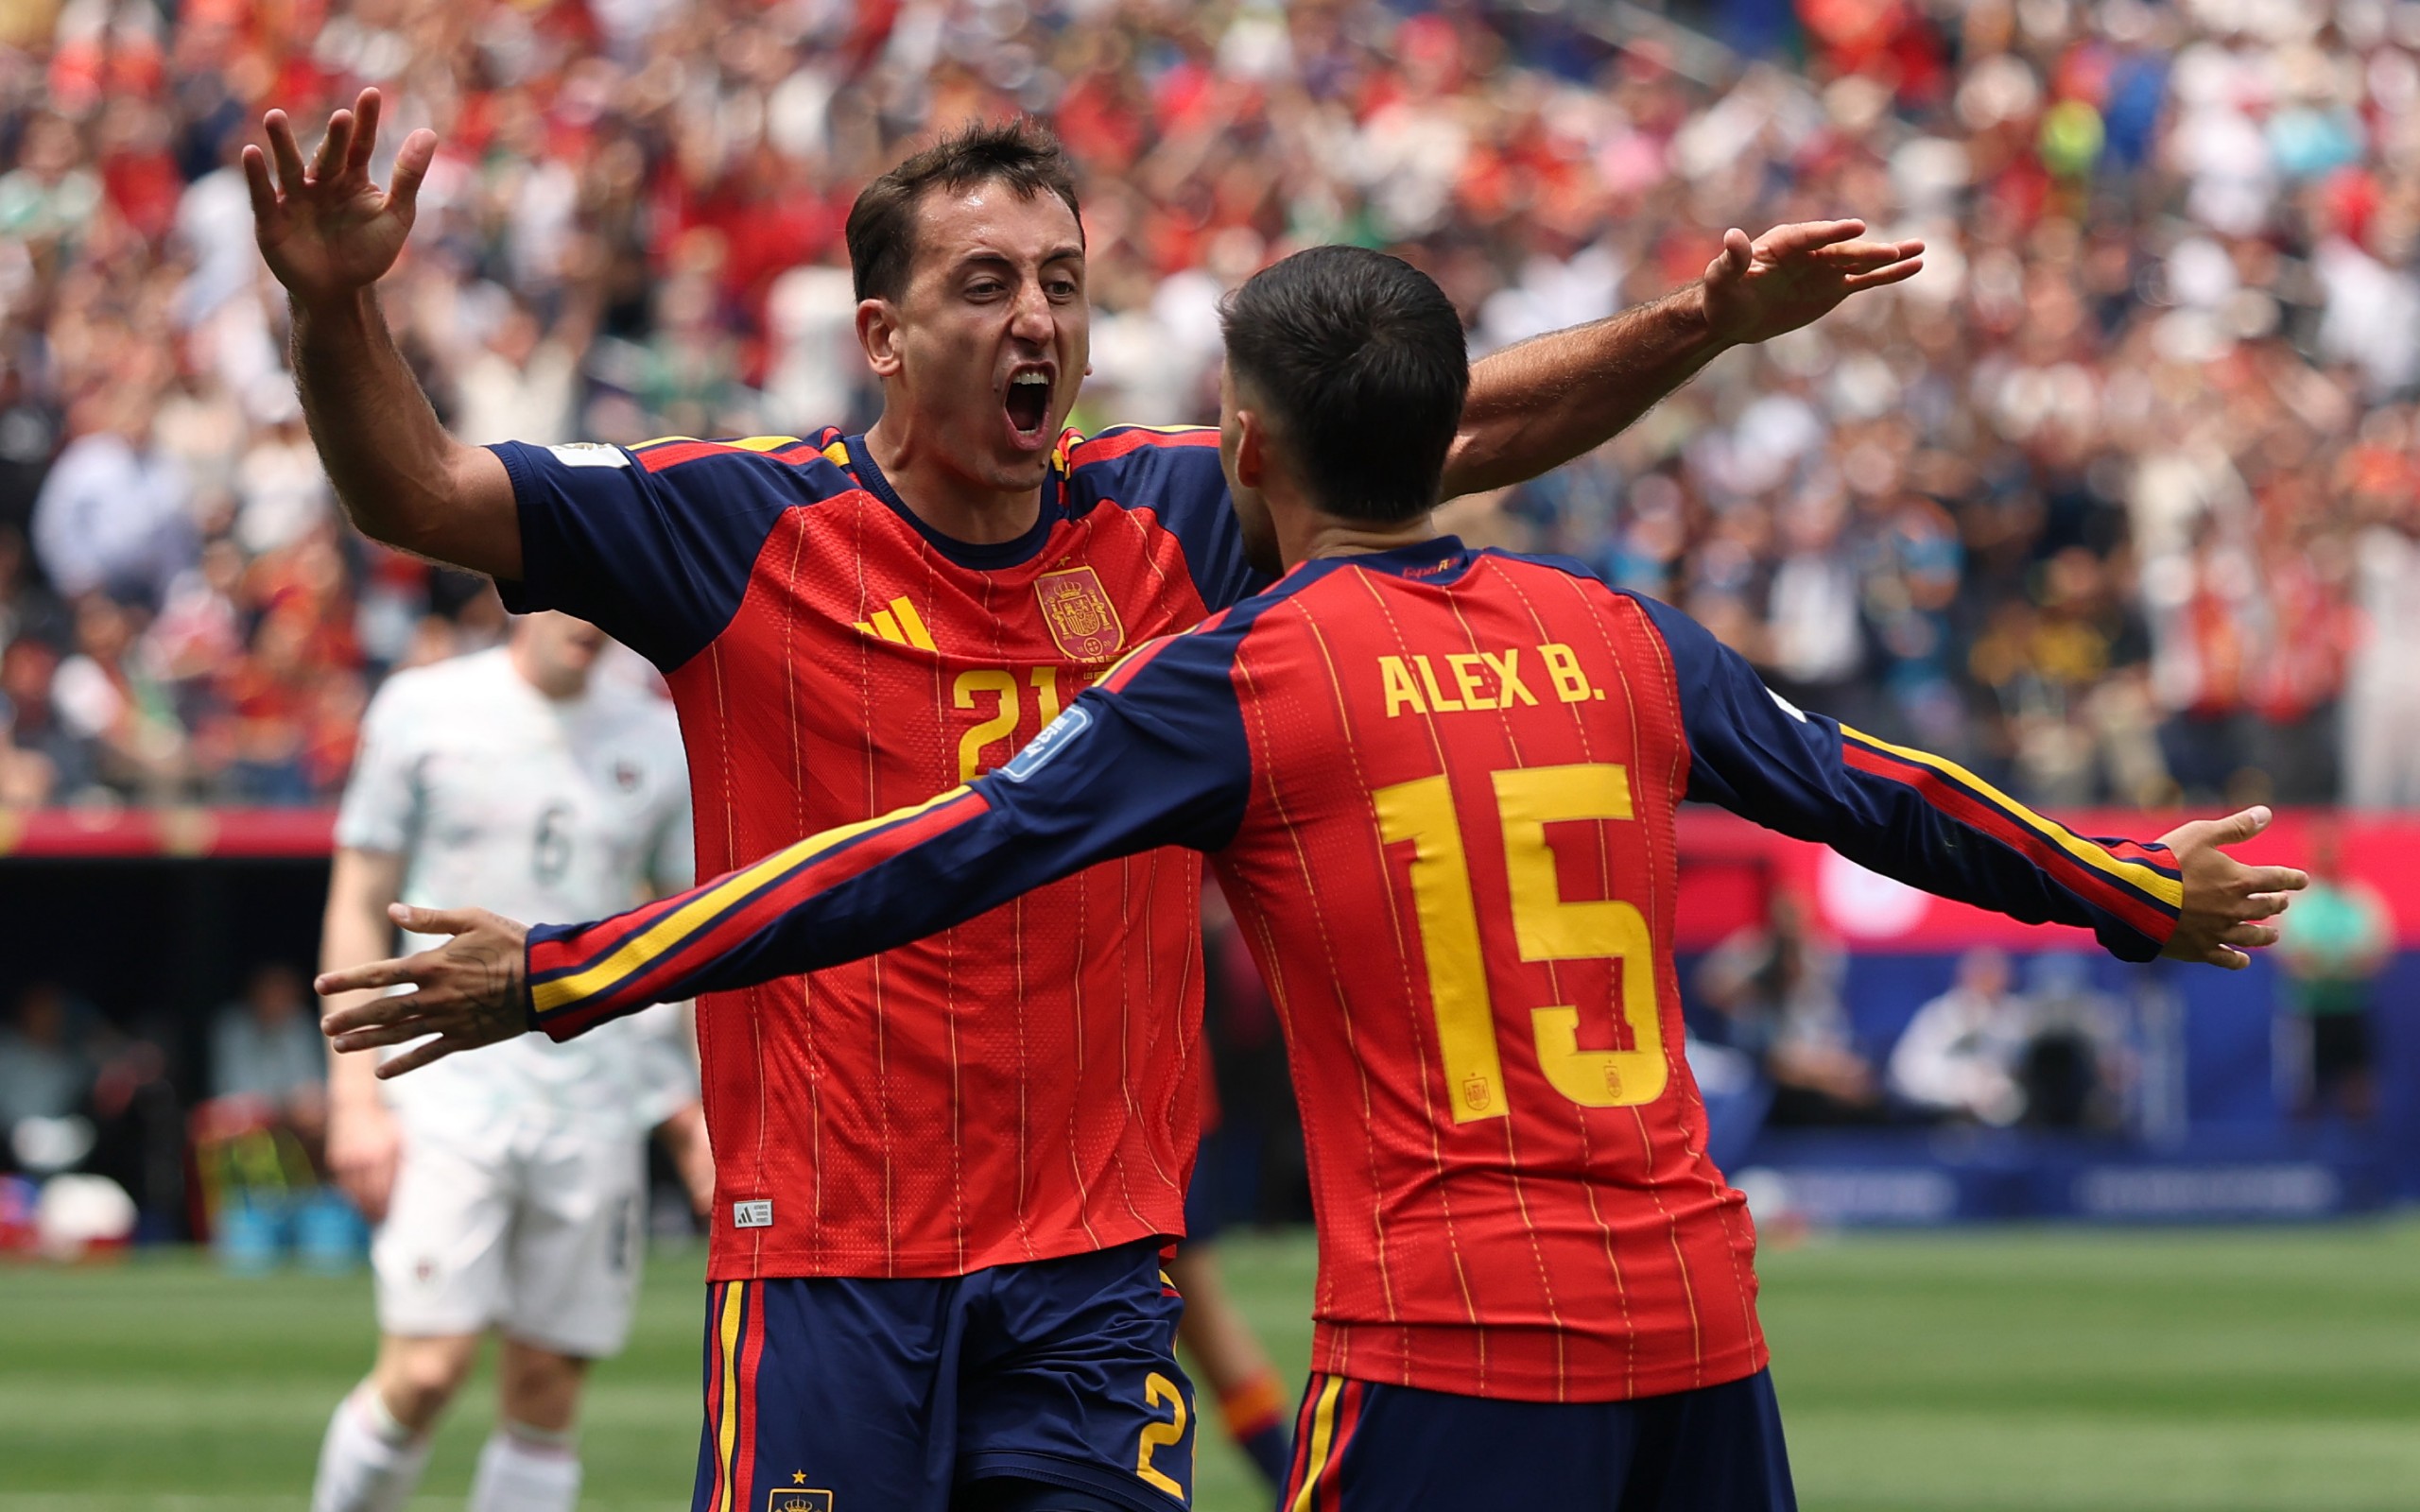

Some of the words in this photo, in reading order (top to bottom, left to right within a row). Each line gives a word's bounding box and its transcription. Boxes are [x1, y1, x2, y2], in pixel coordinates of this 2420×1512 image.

[953, 665, 1060, 784] 21
[1377, 648, 1540, 718] ALEX
[1536, 643, 1606, 704] B.
[1372, 763, 1668, 1125] 15
[1136, 1372, 1196, 1501] 2
